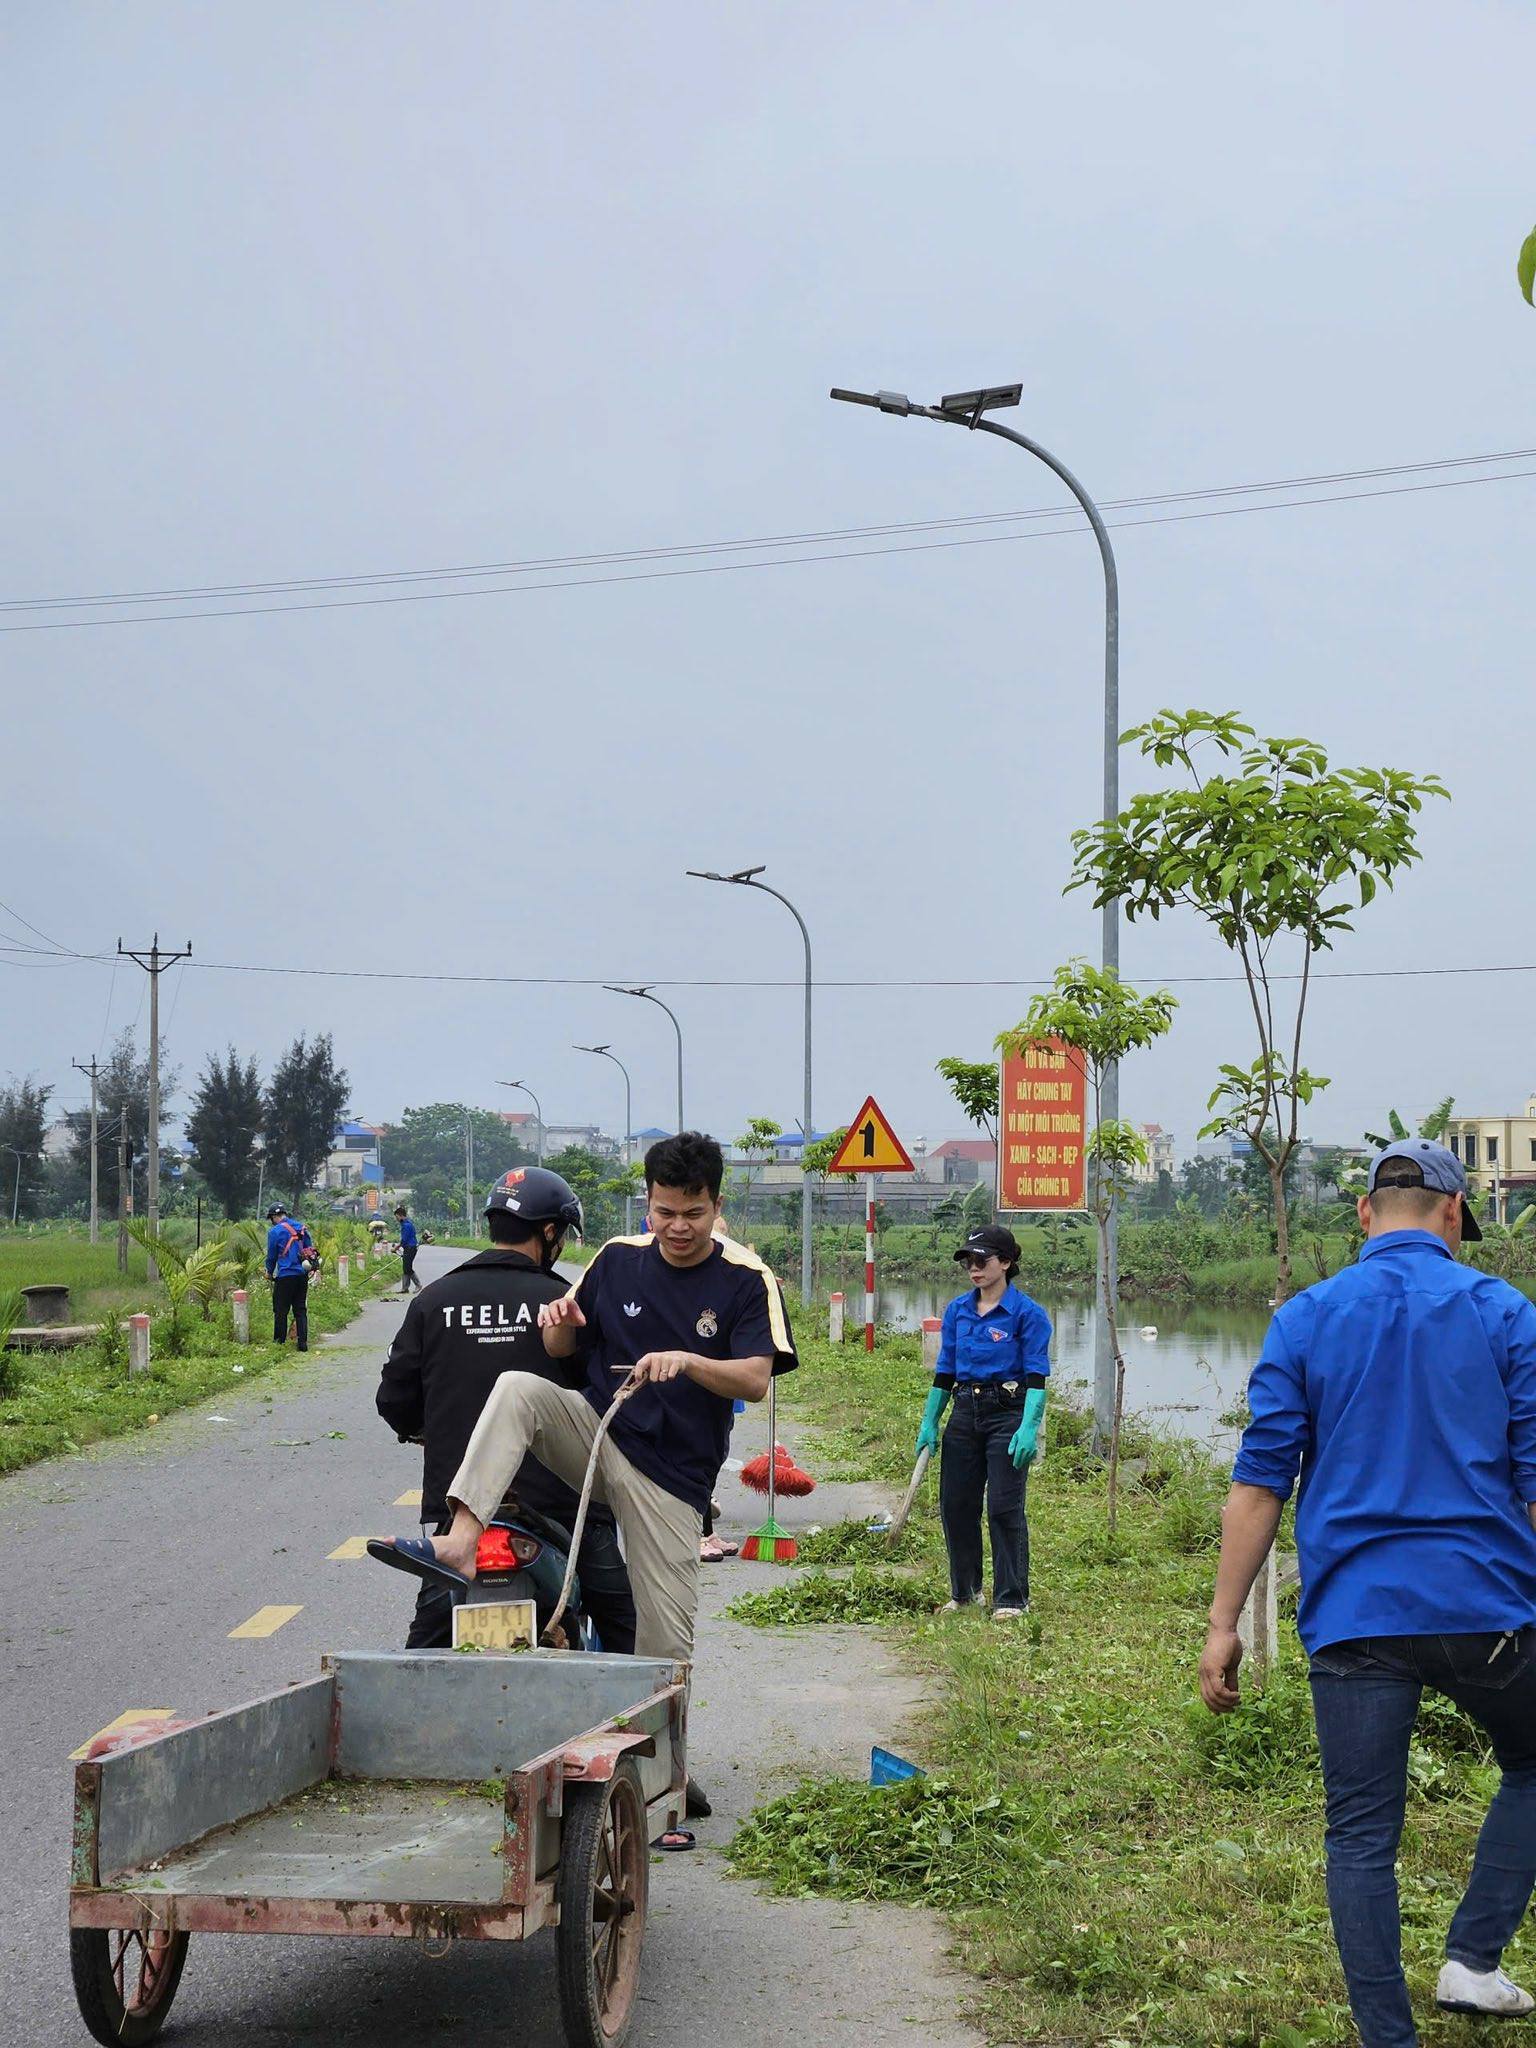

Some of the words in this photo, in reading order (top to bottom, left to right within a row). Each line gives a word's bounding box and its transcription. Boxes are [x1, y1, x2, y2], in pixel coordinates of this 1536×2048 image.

[1033, 1082, 1059, 1101] CHUNG
[1060, 1083, 1073, 1101] TAY
[1009, 1109, 1017, 1132] VÌ
[1018, 1110, 1034, 1136] MỘT
[1035, 1110, 1050, 1132] MÔI
[1051, 1110, 1080, 1133] TRƯỜNG
[1009, 1145, 1031, 1164] XANH
[1036, 1145, 1057, 1168] SẠCH
[1063, 1145, 1078, 1168] ĐẸP
[1034, 1174, 1060, 1196] CHÚNG
[1061, 1177, 1070, 1196] TA
[466, 1327, 494, 1335] EXPERIMENT
